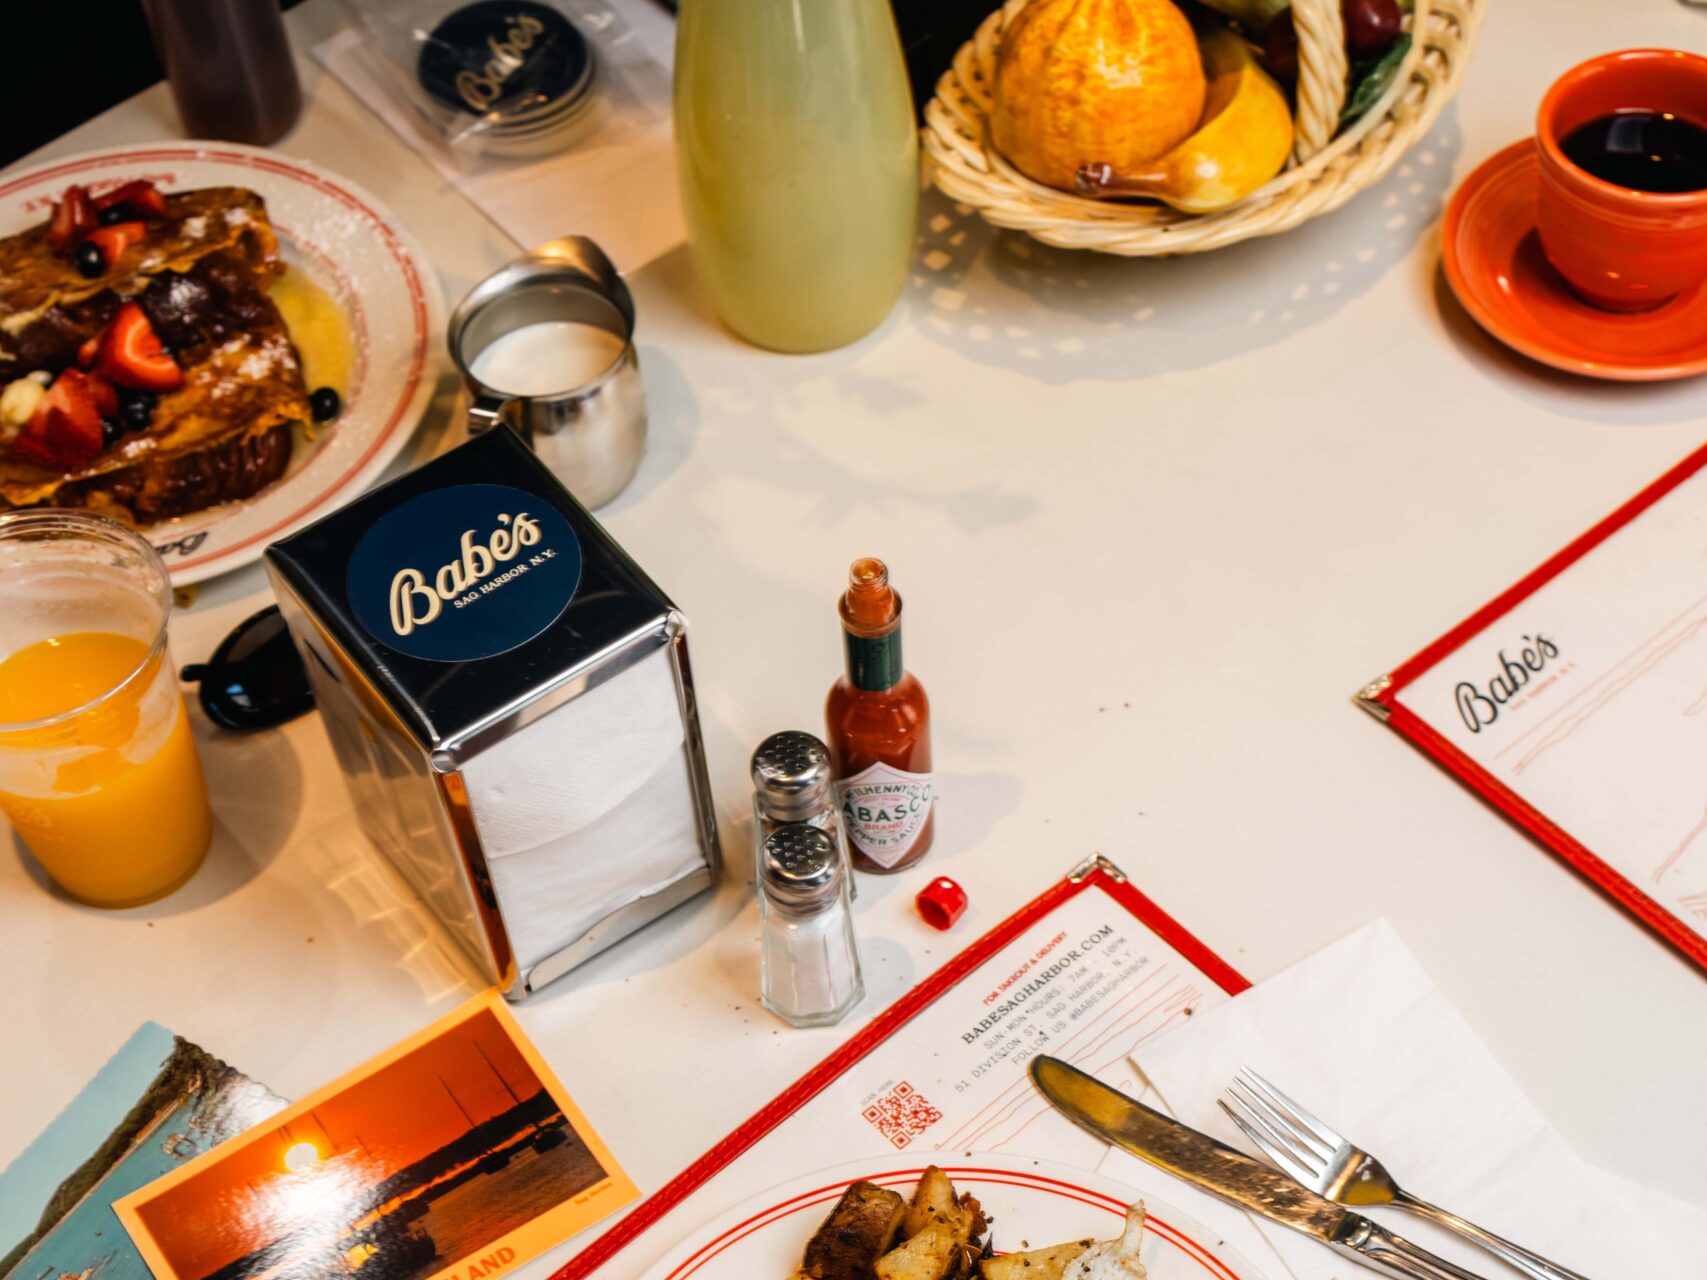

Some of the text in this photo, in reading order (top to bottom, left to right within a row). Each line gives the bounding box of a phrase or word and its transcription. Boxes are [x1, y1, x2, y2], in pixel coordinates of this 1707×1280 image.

[389, 512, 543, 636] Babe's
[454, 591, 481, 608] SAG
[479, 564, 530, 594] HARBOR
[1455, 632, 1559, 734] Babe's
[842, 784, 931, 823] ABASCO
[864, 821, 904, 831] BRAND
[960, 924, 1115, 1045] BABESAGHARBOR.COM
[983, 931, 1067, 1006] FOR TAKEOUT & DELIVERY
[1068, 965, 1089, 983] 7AM
[955, 1078, 971, 1093] 51
[971, 1036, 1022, 1079] DIVISION
[1045, 1001, 1066, 1020] SAG
[1011, 1033, 1050, 1065] FOLLOW
[1051, 1020, 1067, 1034] US
